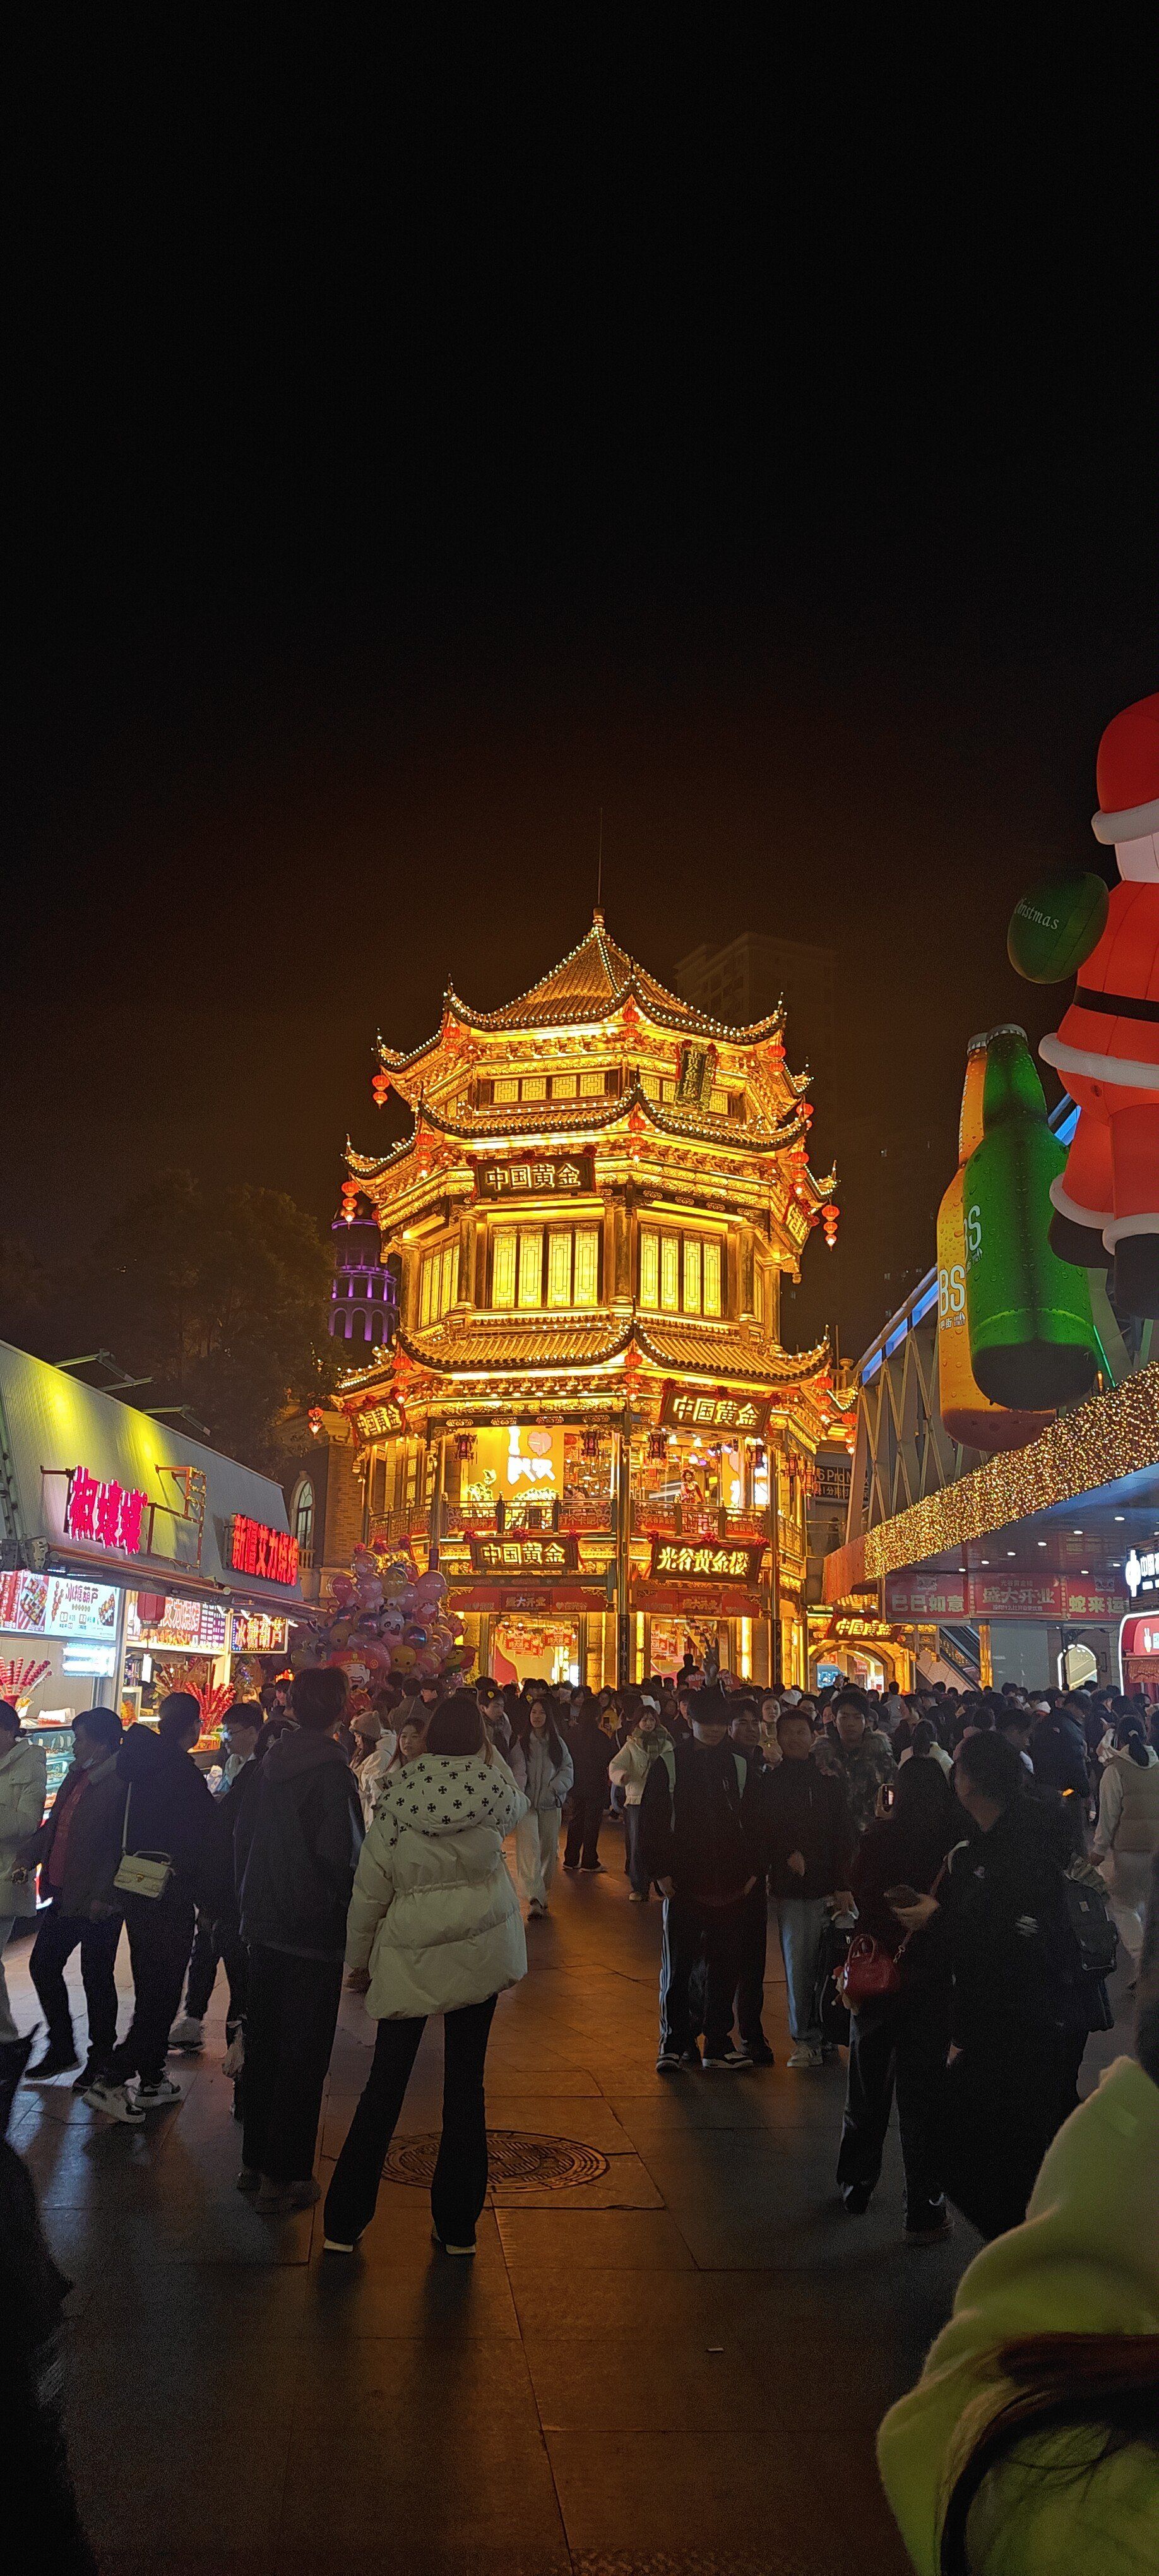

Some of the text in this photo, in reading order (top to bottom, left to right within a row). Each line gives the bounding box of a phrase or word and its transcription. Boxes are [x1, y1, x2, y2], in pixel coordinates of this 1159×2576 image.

[485, 1163, 581, 1191] 中国黄金
[357, 1404, 402, 1437] 中国黄金
[673, 1395, 760, 1426] 中国黄金
[559, 1516, 597, 1525] 打个卡吧
[482, 1542, 565, 1565] 中国黄金
[982, 1586, 1055, 1604] 盛大开业
